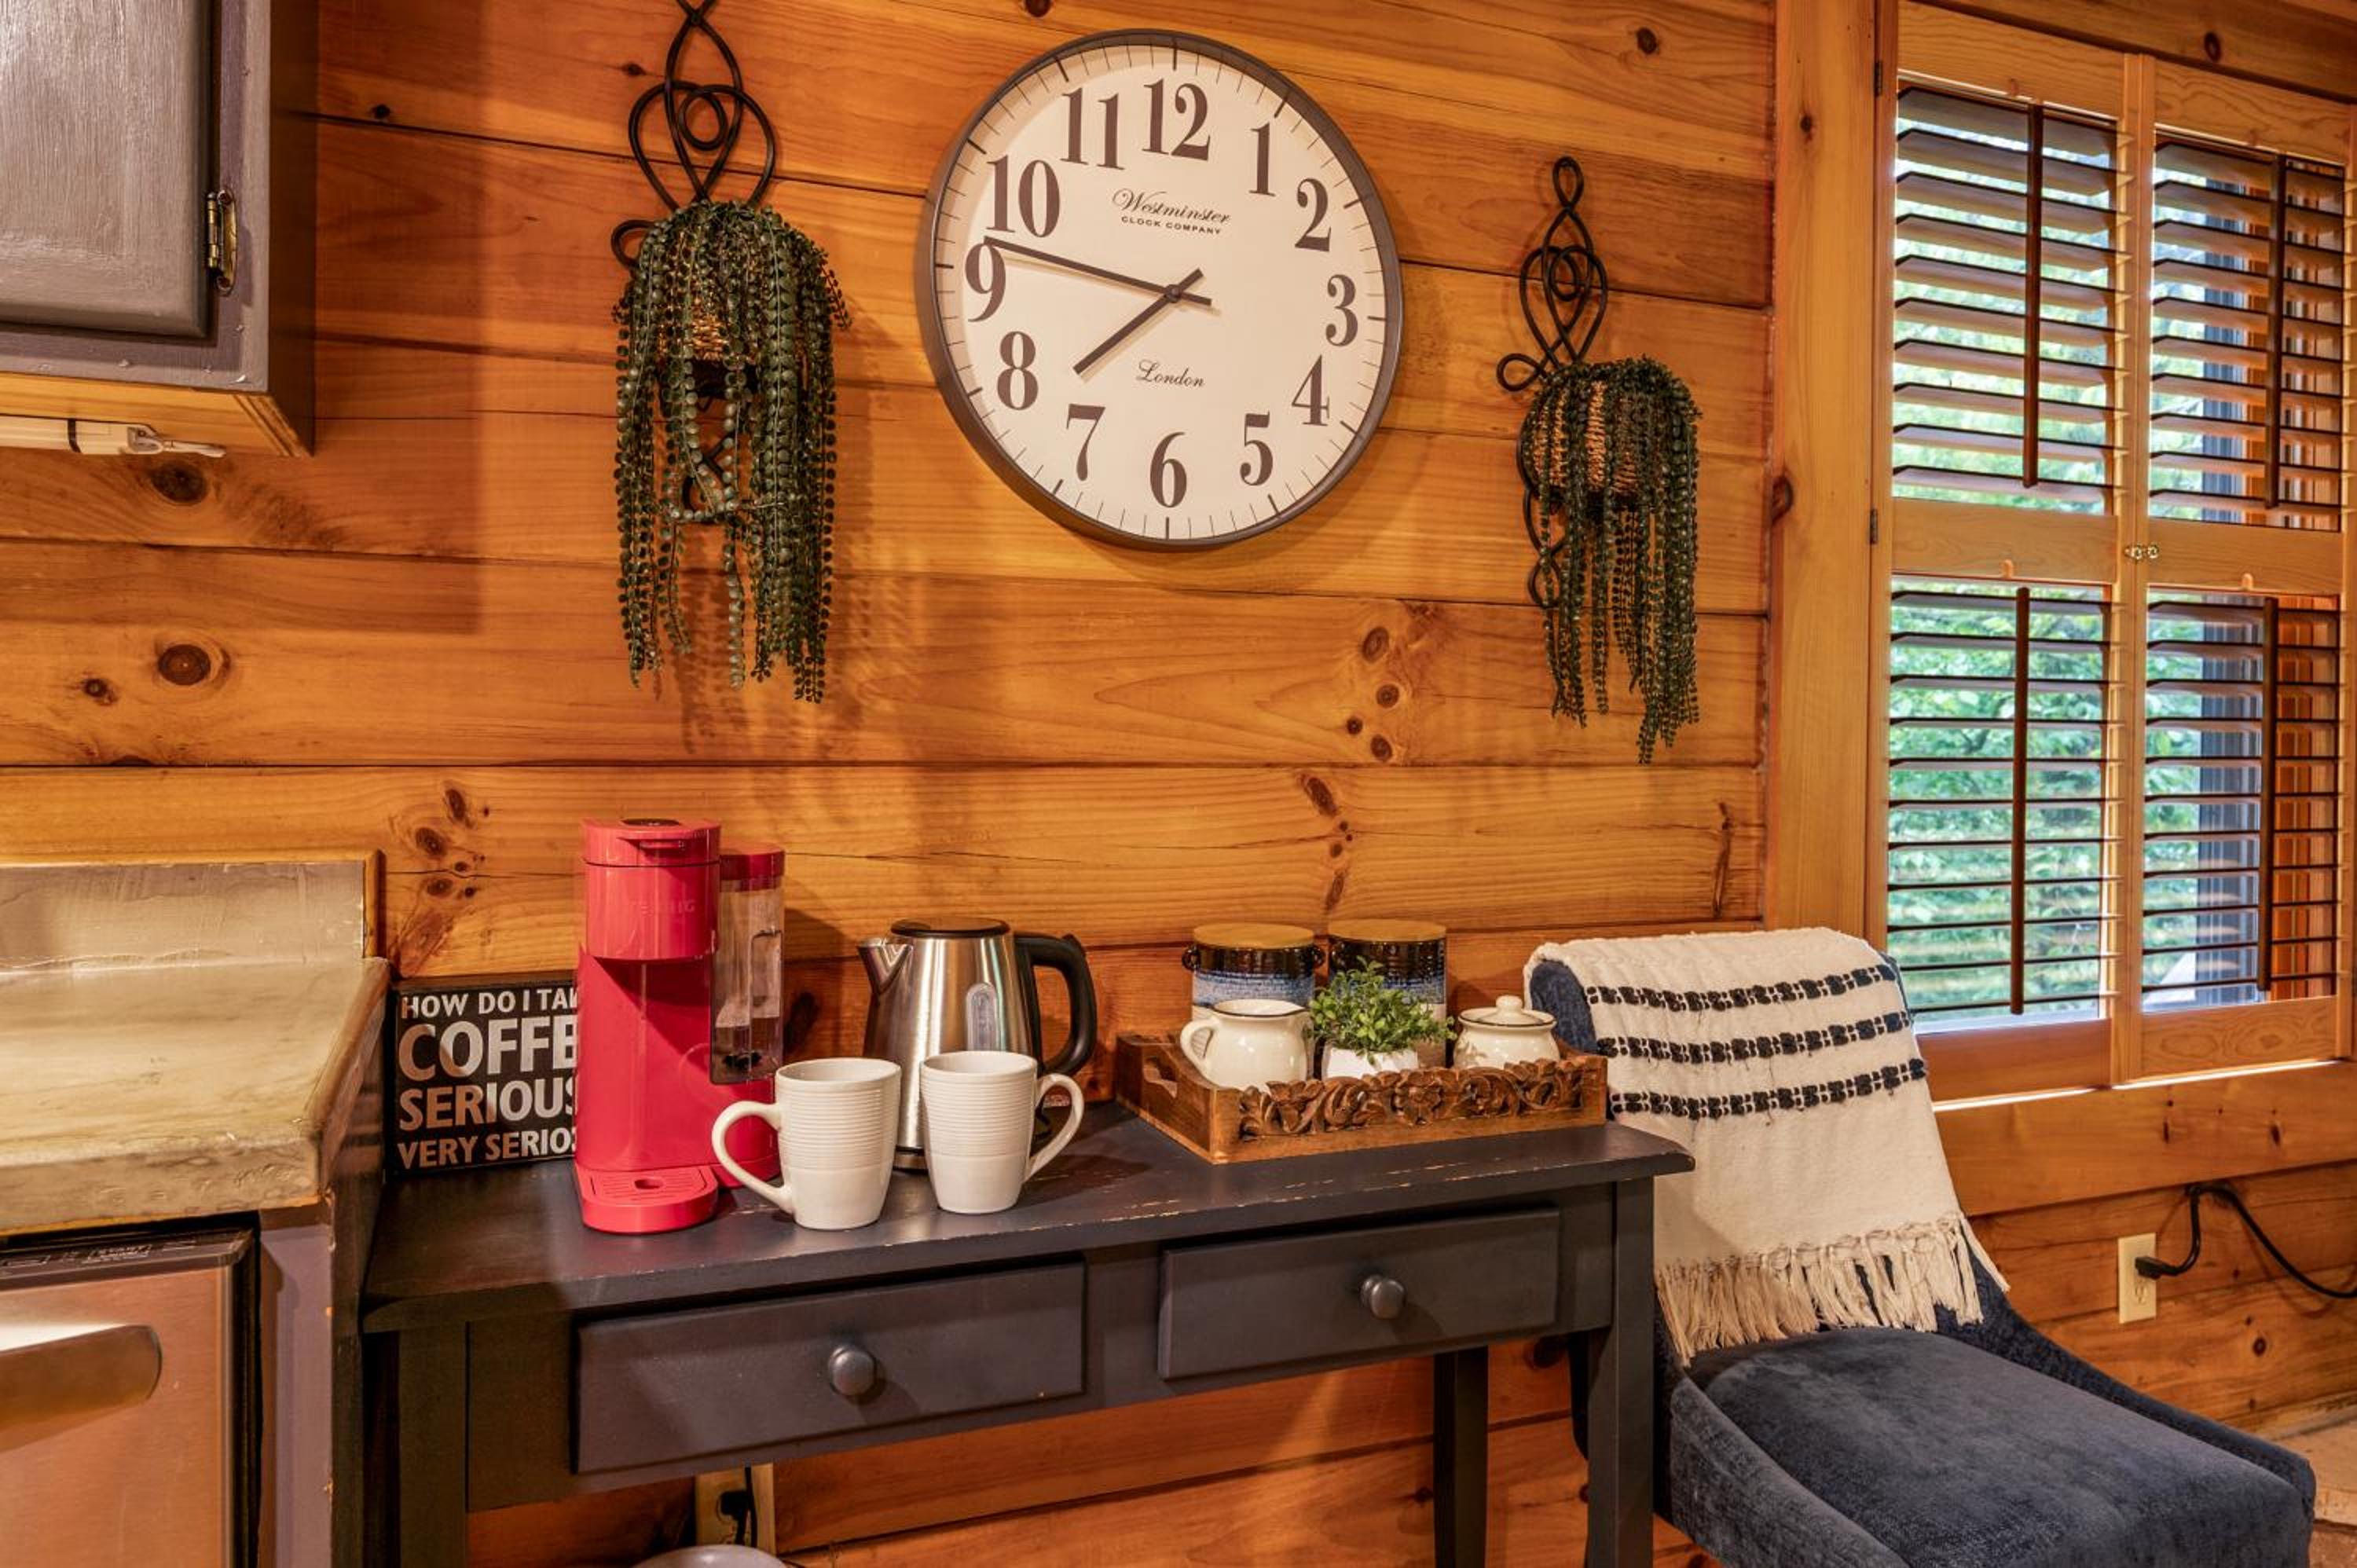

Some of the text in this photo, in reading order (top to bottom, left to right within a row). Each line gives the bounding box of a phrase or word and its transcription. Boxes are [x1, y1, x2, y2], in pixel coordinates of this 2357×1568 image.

[1061, 87, 1126, 170] 11
[1142, 78, 1211, 160] 12
[986, 154, 1061, 238] 10
[1250, 122, 1276, 196] 1
[1112, 188, 1230, 223] Westminster
[1121, 215, 1222, 234] CLOCK COMPANY
[1295, 178, 1332, 252] 2
[965, 242, 1006, 322] 9
[1325, 274, 1358, 347] 3
[996, 331, 1039, 410] 8
[1136, 359, 1204, 387] London
[1291, 354, 1331, 427] 4
[1065, 403, 1106, 482] 7
[1149, 431, 1188, 509] 6
[1239, 410, 1274, 487] 5
[401, 993, 469, 1019] HOW
[478, 991, 516, 1014] DO
[522, 989, 530, 1012] I
[397, 1127, 577, 1170] VERY SERIO
